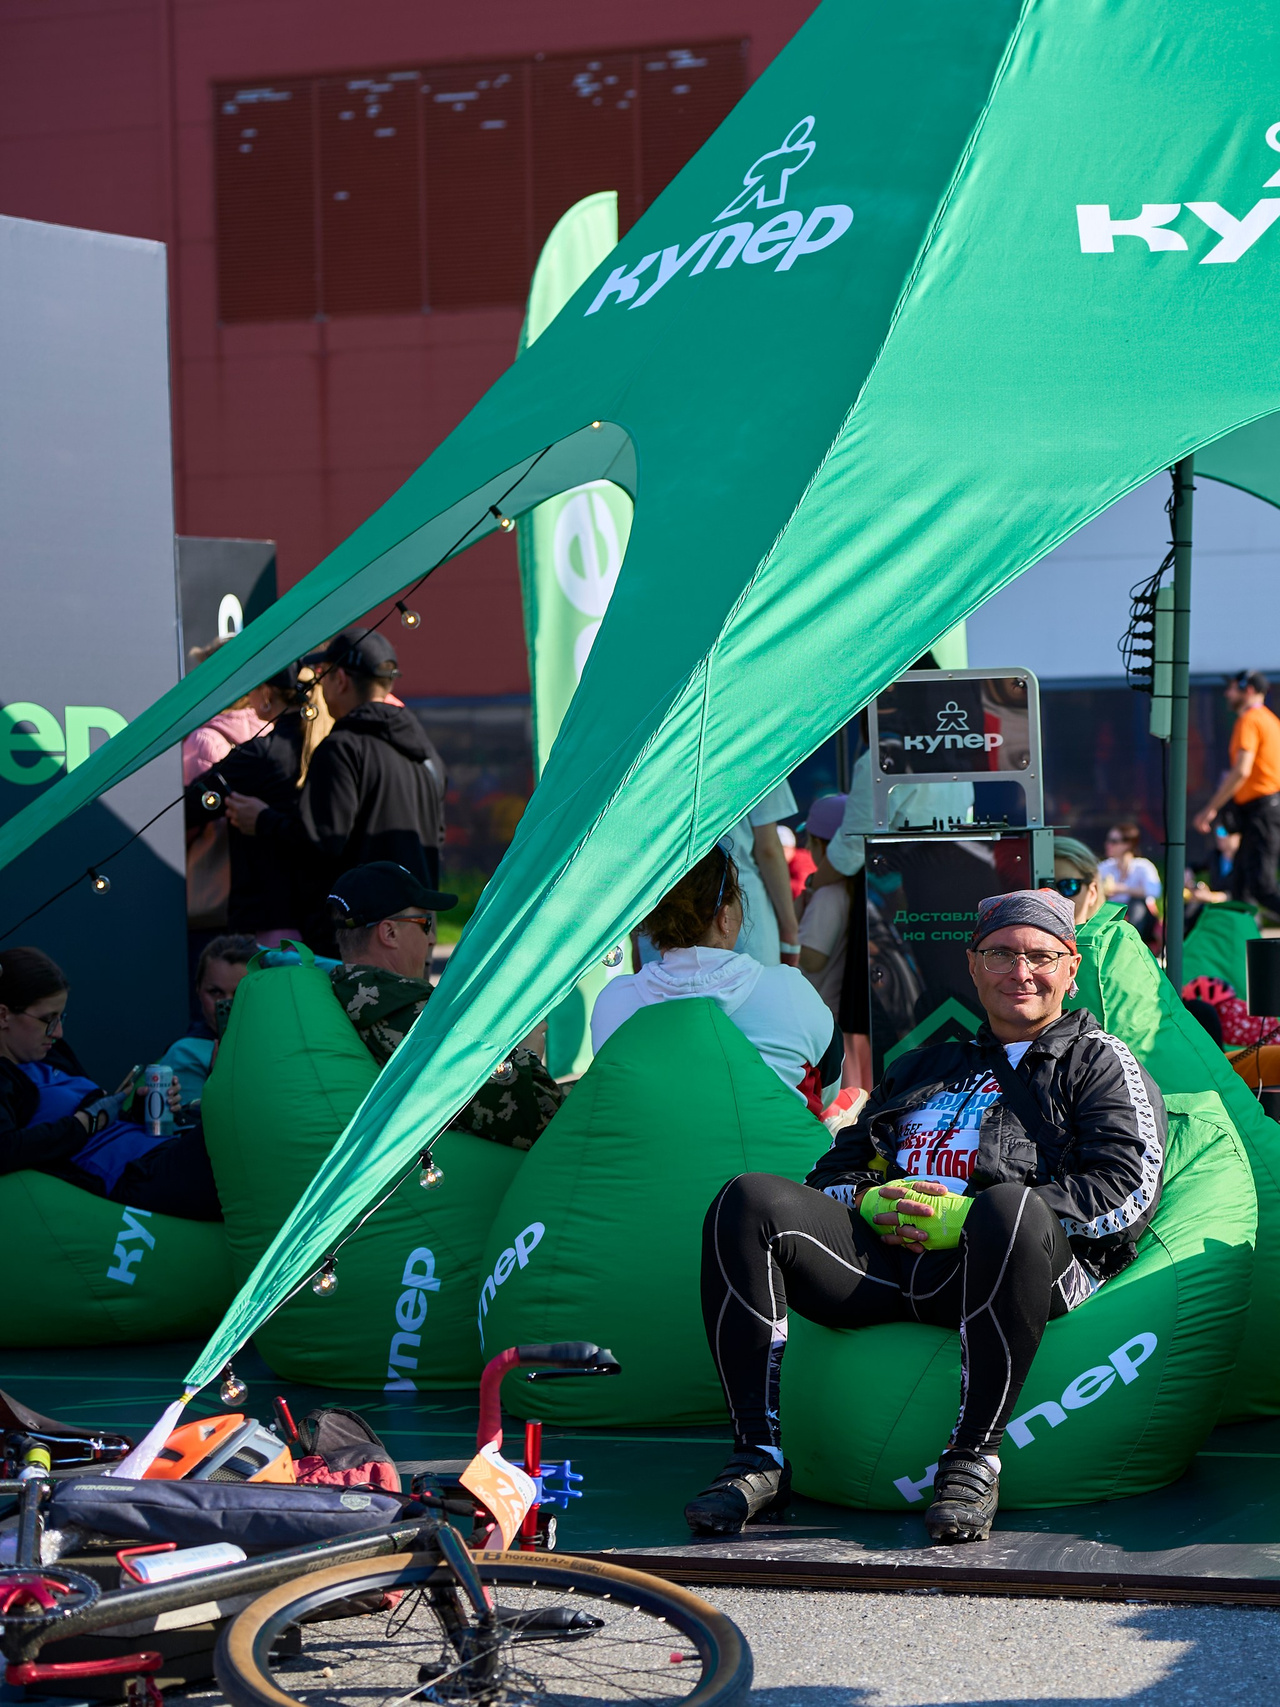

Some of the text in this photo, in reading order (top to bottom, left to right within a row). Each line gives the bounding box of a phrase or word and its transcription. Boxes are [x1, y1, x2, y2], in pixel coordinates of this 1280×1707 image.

[583, 203, 854, 317] купер
[903, 733, 1004, 754] купер
[903, 931, 925, 941] на
[106, 1205, 156, 1286] ку
[504, 1553, 549, 1564] horizon
